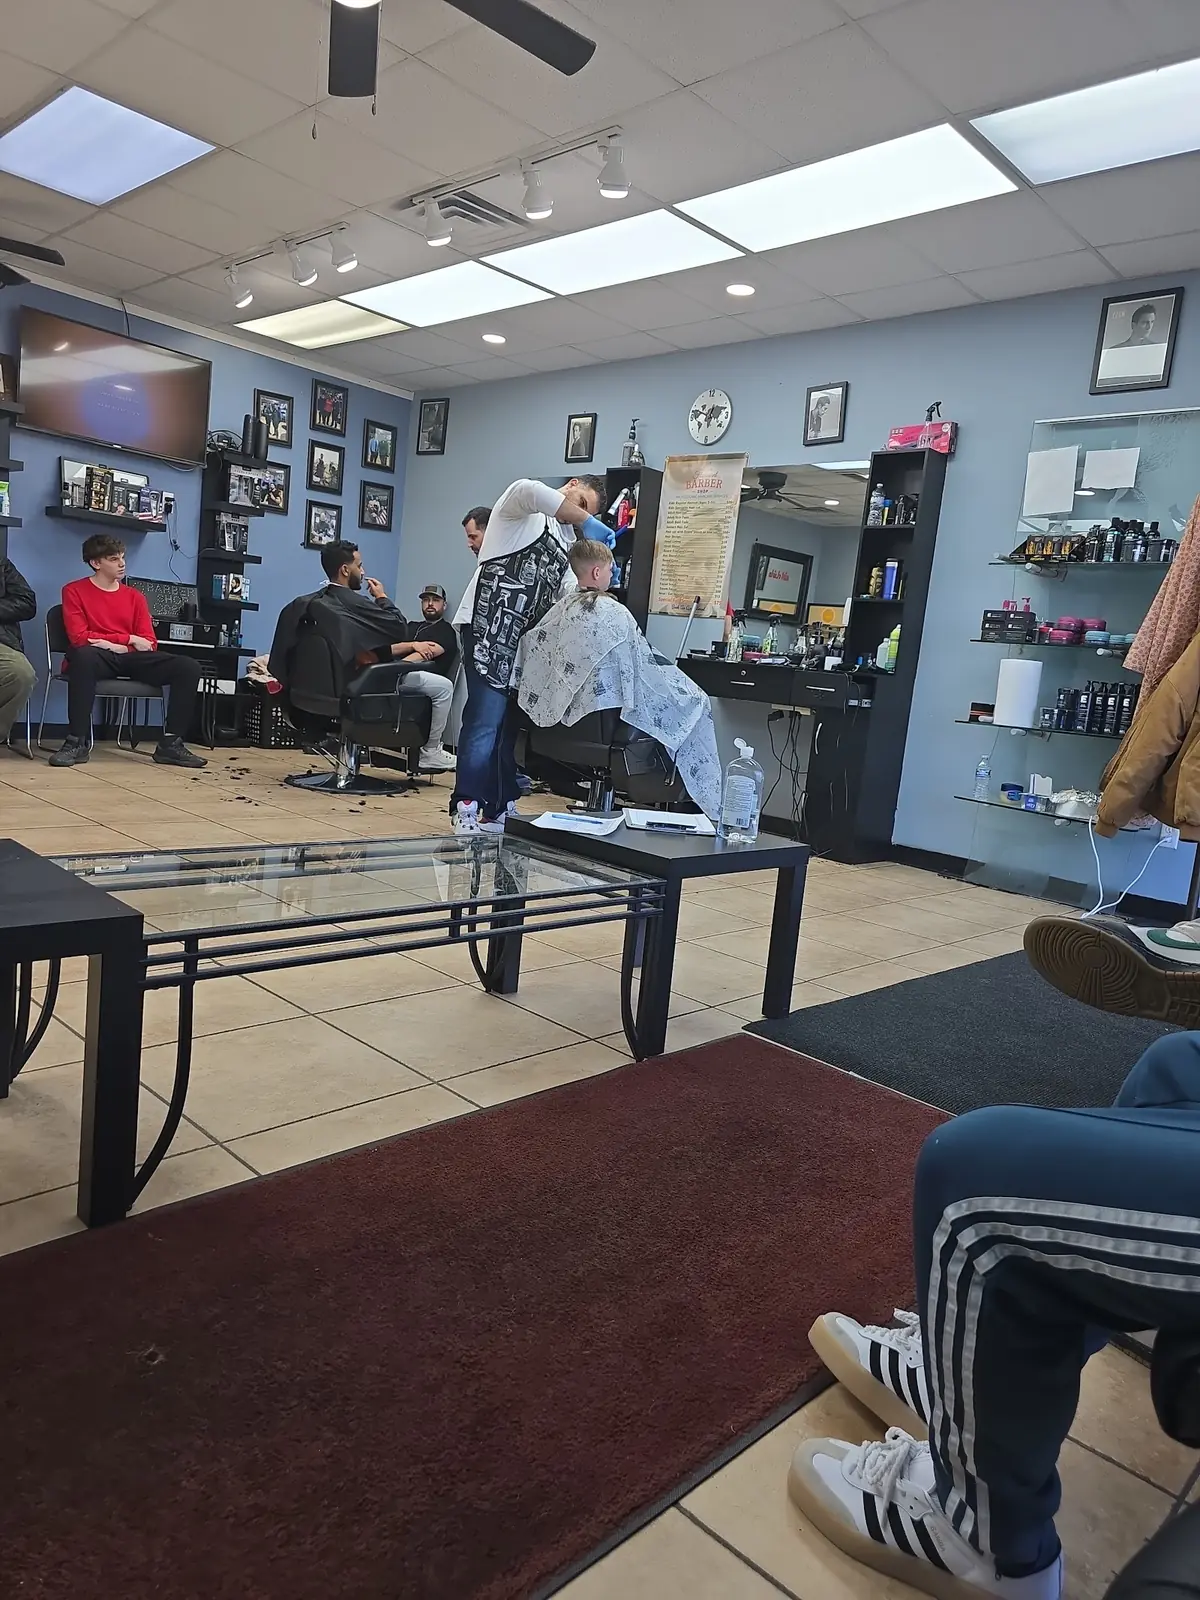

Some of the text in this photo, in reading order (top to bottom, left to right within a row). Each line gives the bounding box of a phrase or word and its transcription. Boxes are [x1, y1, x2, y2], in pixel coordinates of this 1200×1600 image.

[709, 389, 715, 397] 12
[724, 411, 729, 419] 3
[703, 435, 708, 443] 6
[686, 479, 723, 489] BARBER
[147, 583, 196, 597] BARBER
[157, 594, 189, 607] SHOP
[1080, 695, 1088, 703] E
[1095, 696, 1103, 705] E
[1107, 697, 1115, 706] E
[1123, 698, 1130, 707] E
